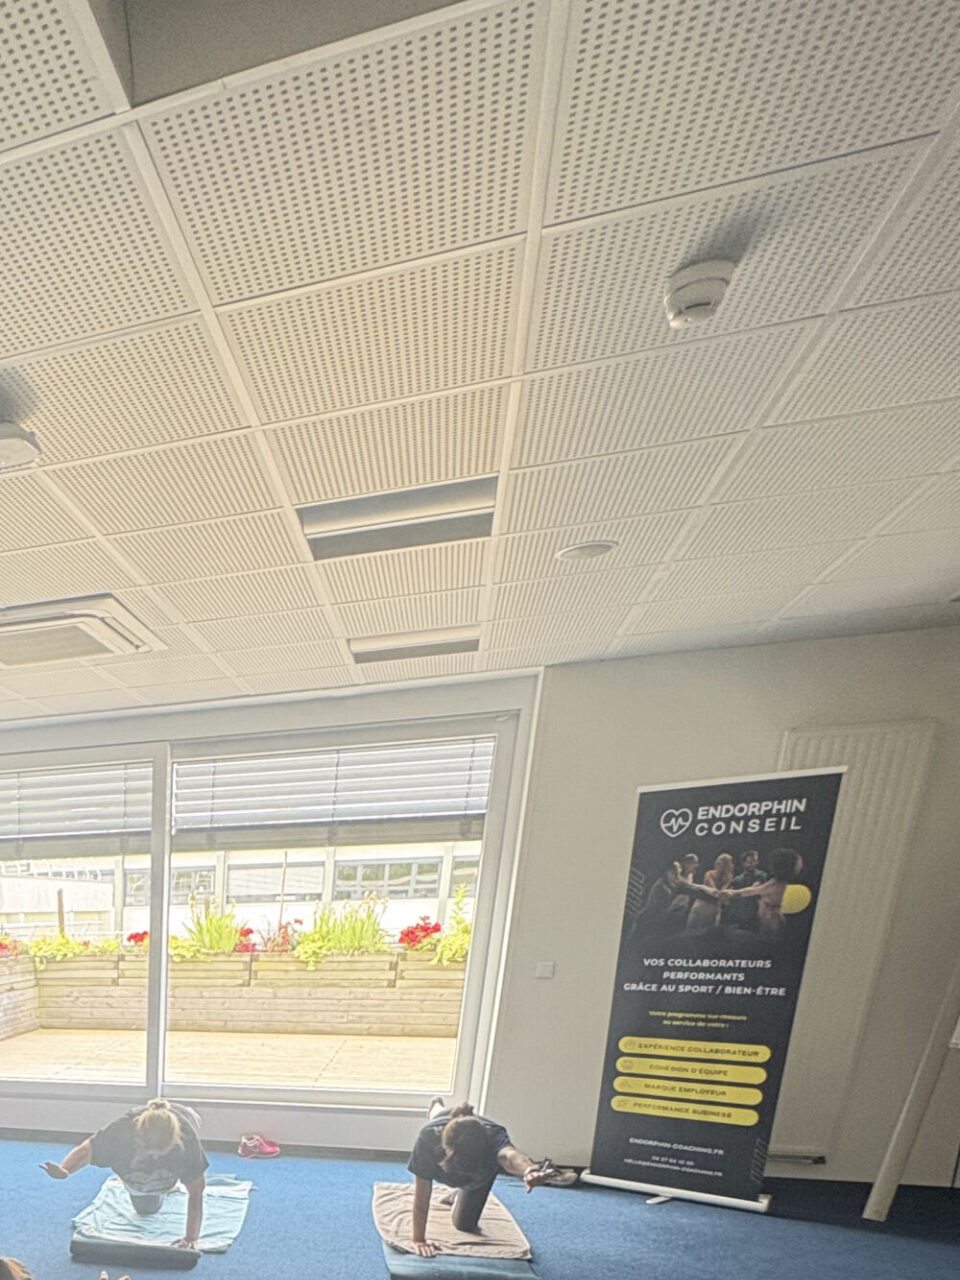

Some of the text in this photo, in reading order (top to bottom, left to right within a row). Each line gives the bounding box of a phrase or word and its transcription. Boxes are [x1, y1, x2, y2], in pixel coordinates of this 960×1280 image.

[697, 798, 807, 820] ENDORPHIN
[695, 816, 802, 836] CONSEIL
[643, 958, 772, 968] VOS COLLABORATEURS
[663, 971, 745, 981] PERFORMANTS
[623, 982, 658, 992] GRÂCE
[678, 985, 714, 993] SPORT
[724, 985, 787, 996] BIEN-ÊTRE
[638, 1043, 760, 1057] EXPÉRIENCE COLLABORATEUR
[644, 1083, 727, 1096] MARQUE EMPLOYEUR
[633, 1102, 732, 1118] PERFORMANCE BUSINESS
